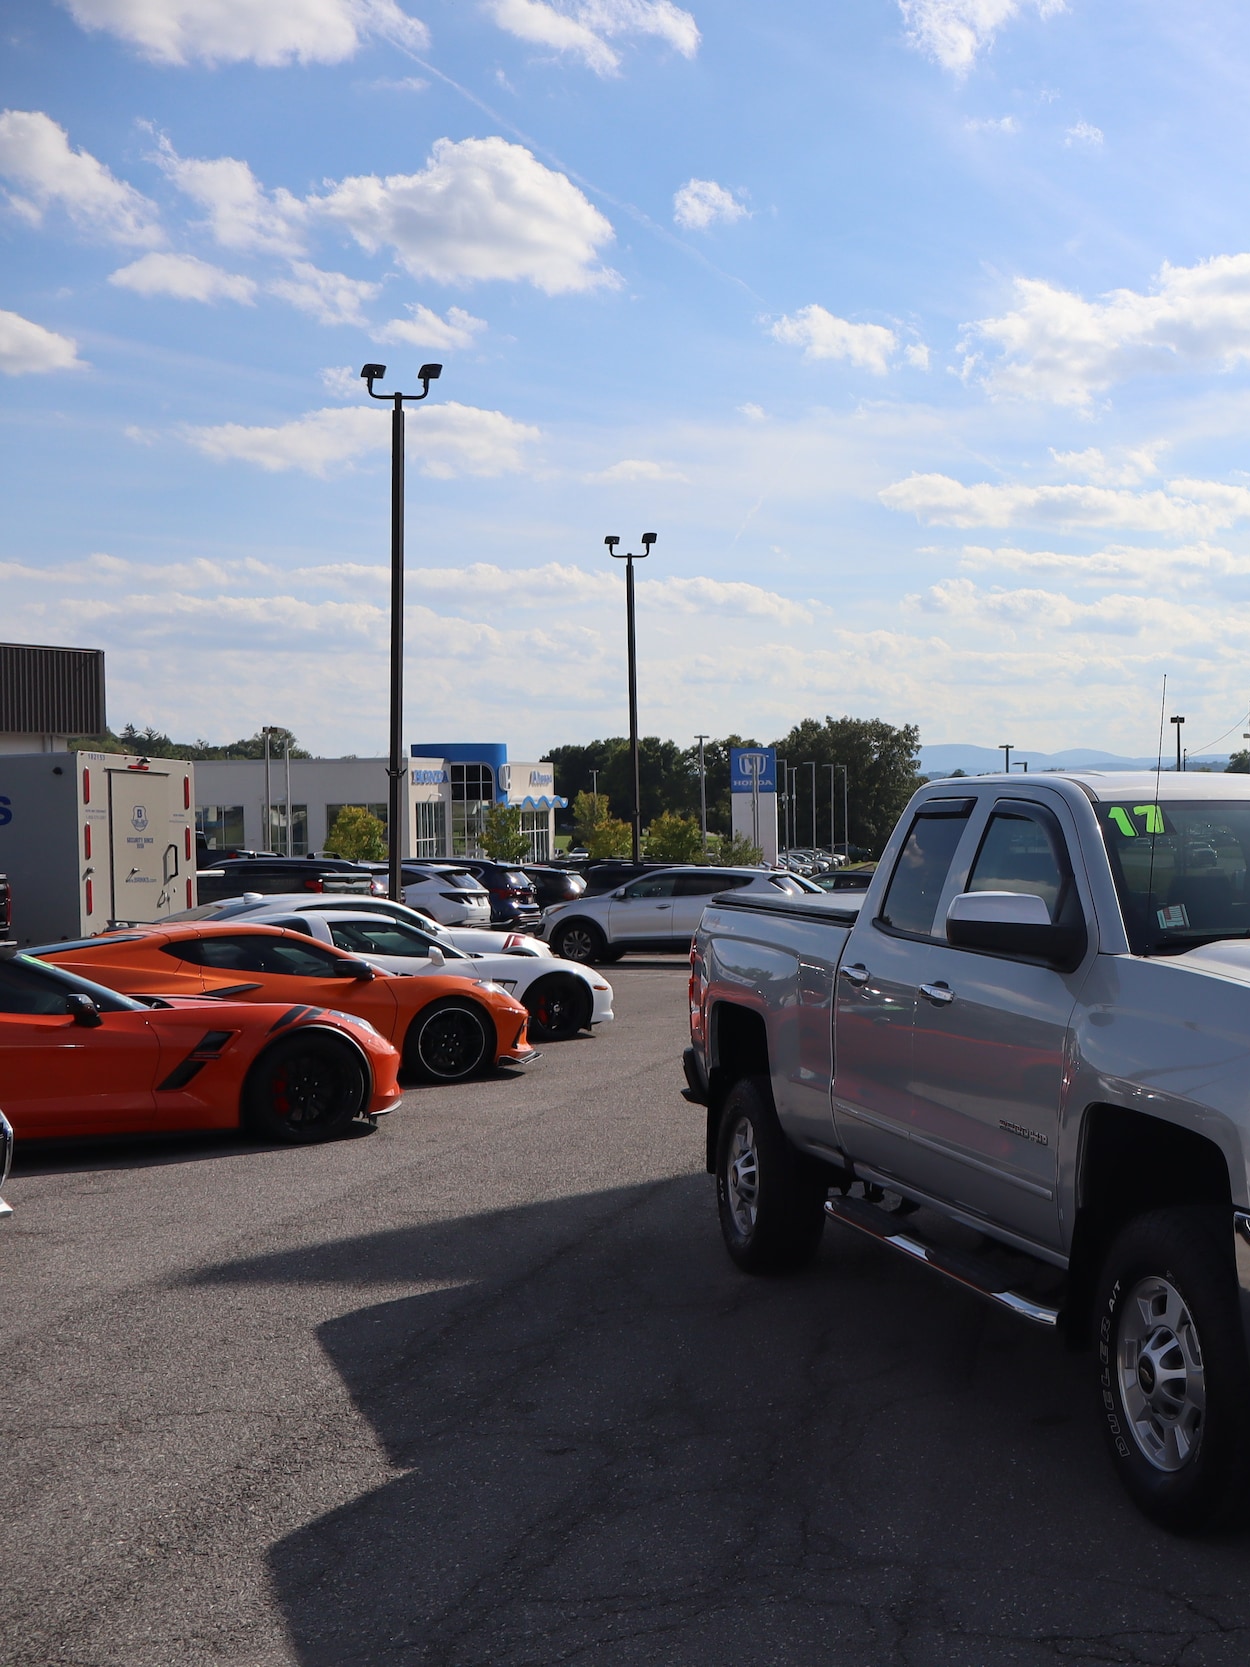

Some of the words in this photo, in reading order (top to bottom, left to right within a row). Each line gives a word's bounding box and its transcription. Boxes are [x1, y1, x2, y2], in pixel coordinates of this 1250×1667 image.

[412, 770, 448, 784] HONDA
[1108, 804, 1165, 837] 17
[1108, 1280, 1121, 1313] A/T
